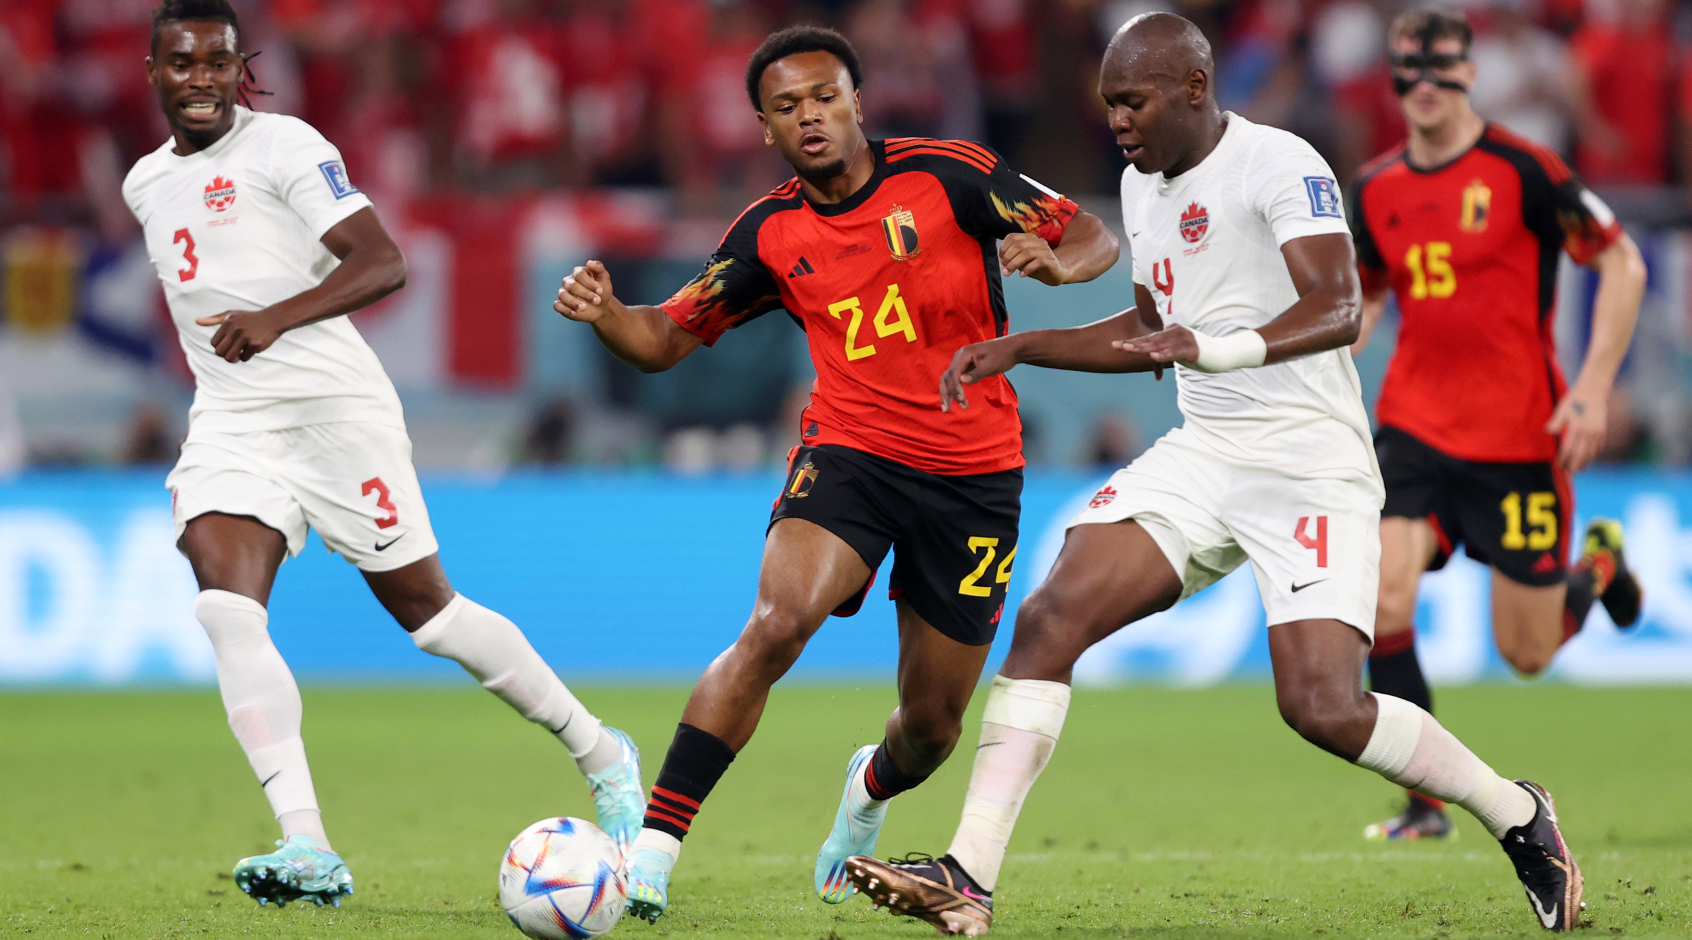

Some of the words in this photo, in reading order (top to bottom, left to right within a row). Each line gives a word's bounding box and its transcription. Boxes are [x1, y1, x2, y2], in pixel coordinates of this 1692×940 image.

[204, 188, 236, 200] CANADA
[1180, 216, 1209, 229] CANADA
[173, 227, 198, 282] 3
[1405, 241, 1457, 300] 15
[1153, 258, 1174, 314] 4
[828, 284, 917, 361] 24
[361, 476, 398, 530] 3
[1501, 491, 1557, 550] 15
[958, 536, 1018, 597] 24
[1294, 516, 1328, 568] 4
